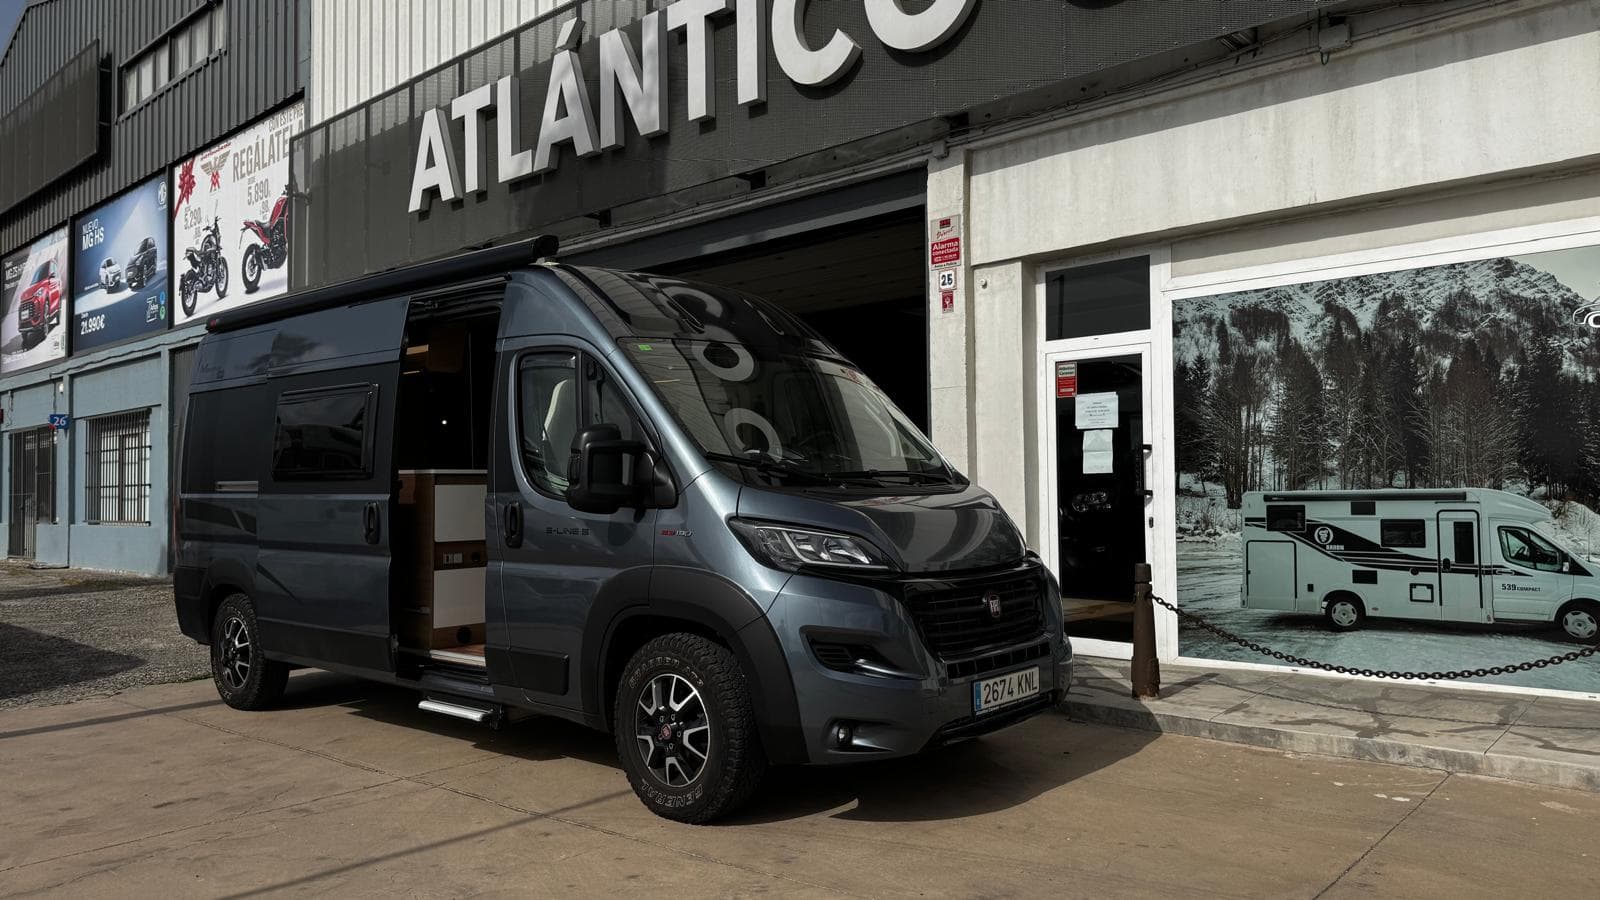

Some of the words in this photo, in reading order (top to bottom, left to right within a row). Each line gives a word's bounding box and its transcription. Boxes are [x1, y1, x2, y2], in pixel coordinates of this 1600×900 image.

[94, 226, 105, 246] HS
[932, 240, 959, 252] Alarma
[941, 273, 953, 287] 25
[80, 313, 105, 336] 21.990€
[53, 416, 67, 426] 26
[1501, 583, 1517, 591] 539
[983, 677, 1015, 705] 2674
[1017, 670, 1038, 696] KNL
